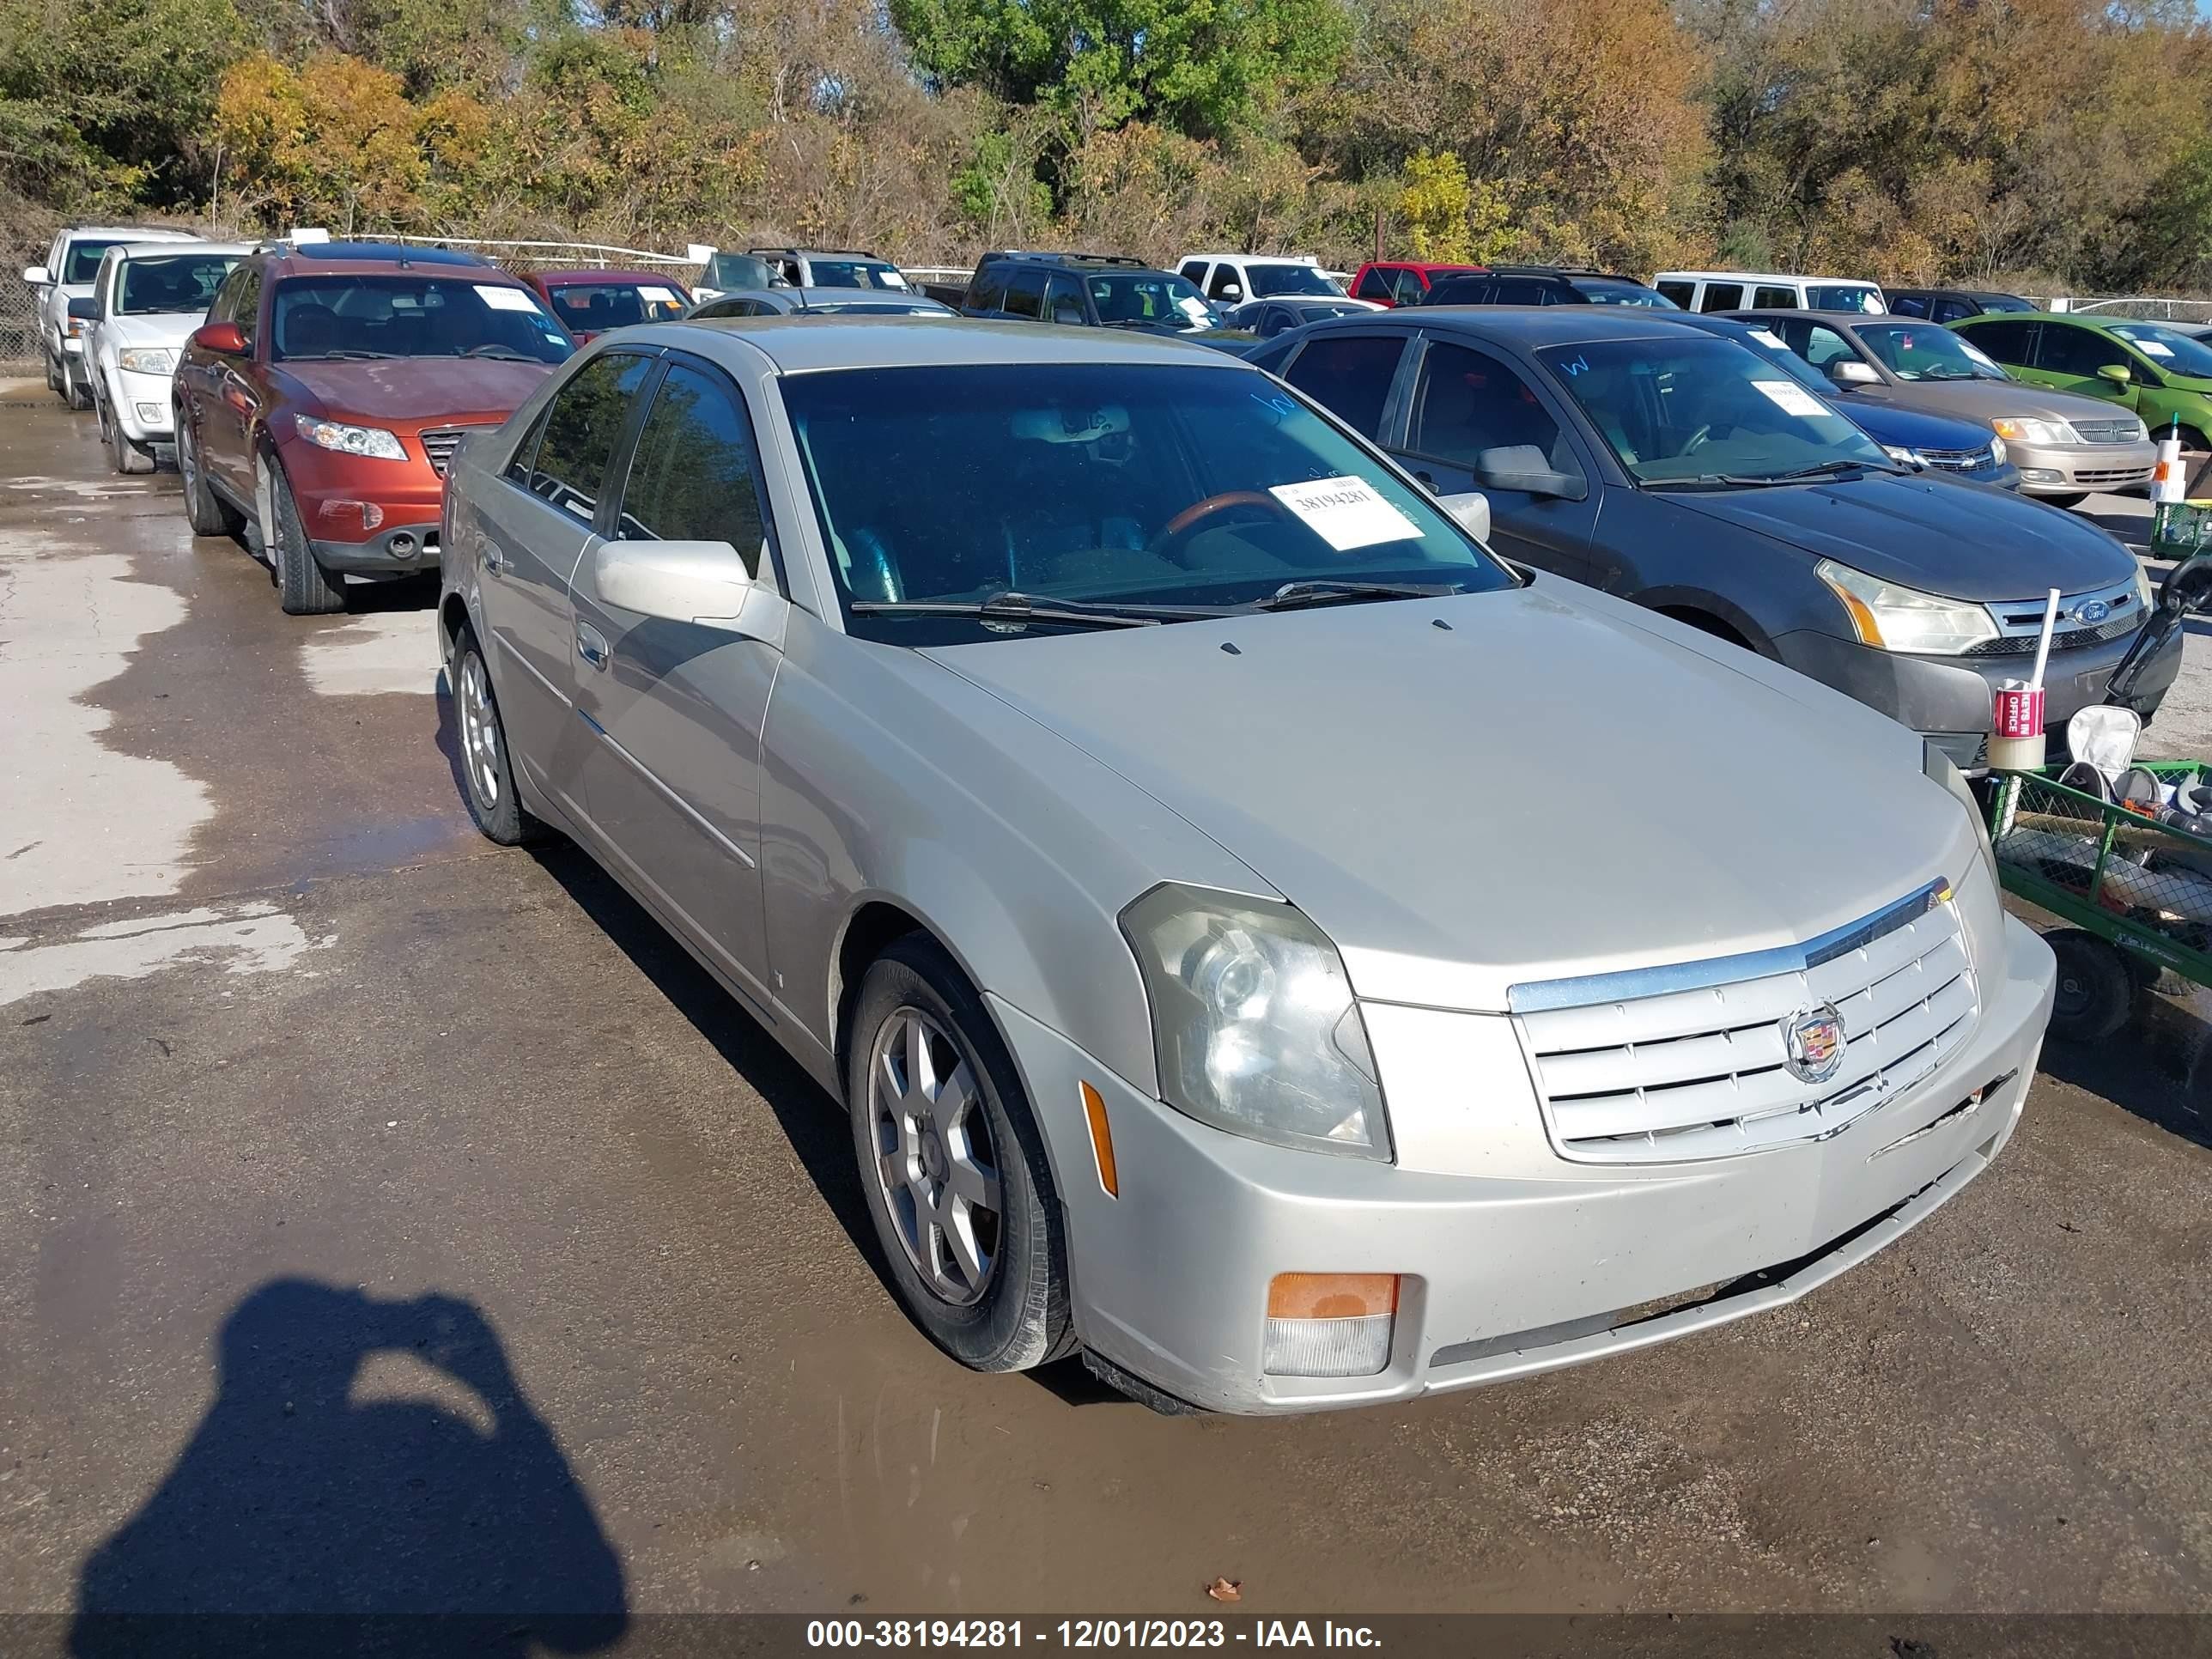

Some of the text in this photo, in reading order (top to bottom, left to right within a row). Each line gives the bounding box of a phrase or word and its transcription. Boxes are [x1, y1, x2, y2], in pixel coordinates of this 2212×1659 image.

[1559, 354, 1589, 376] W
[1249, 391, 1295, 416] W
[1294, 489, 1371, 512] 38194281
[2087, 605, 2105, 620] Ford
[2008, 696, 2019, 732] OFFICE
[2020, 693, 2031, 735] KEYS IN
